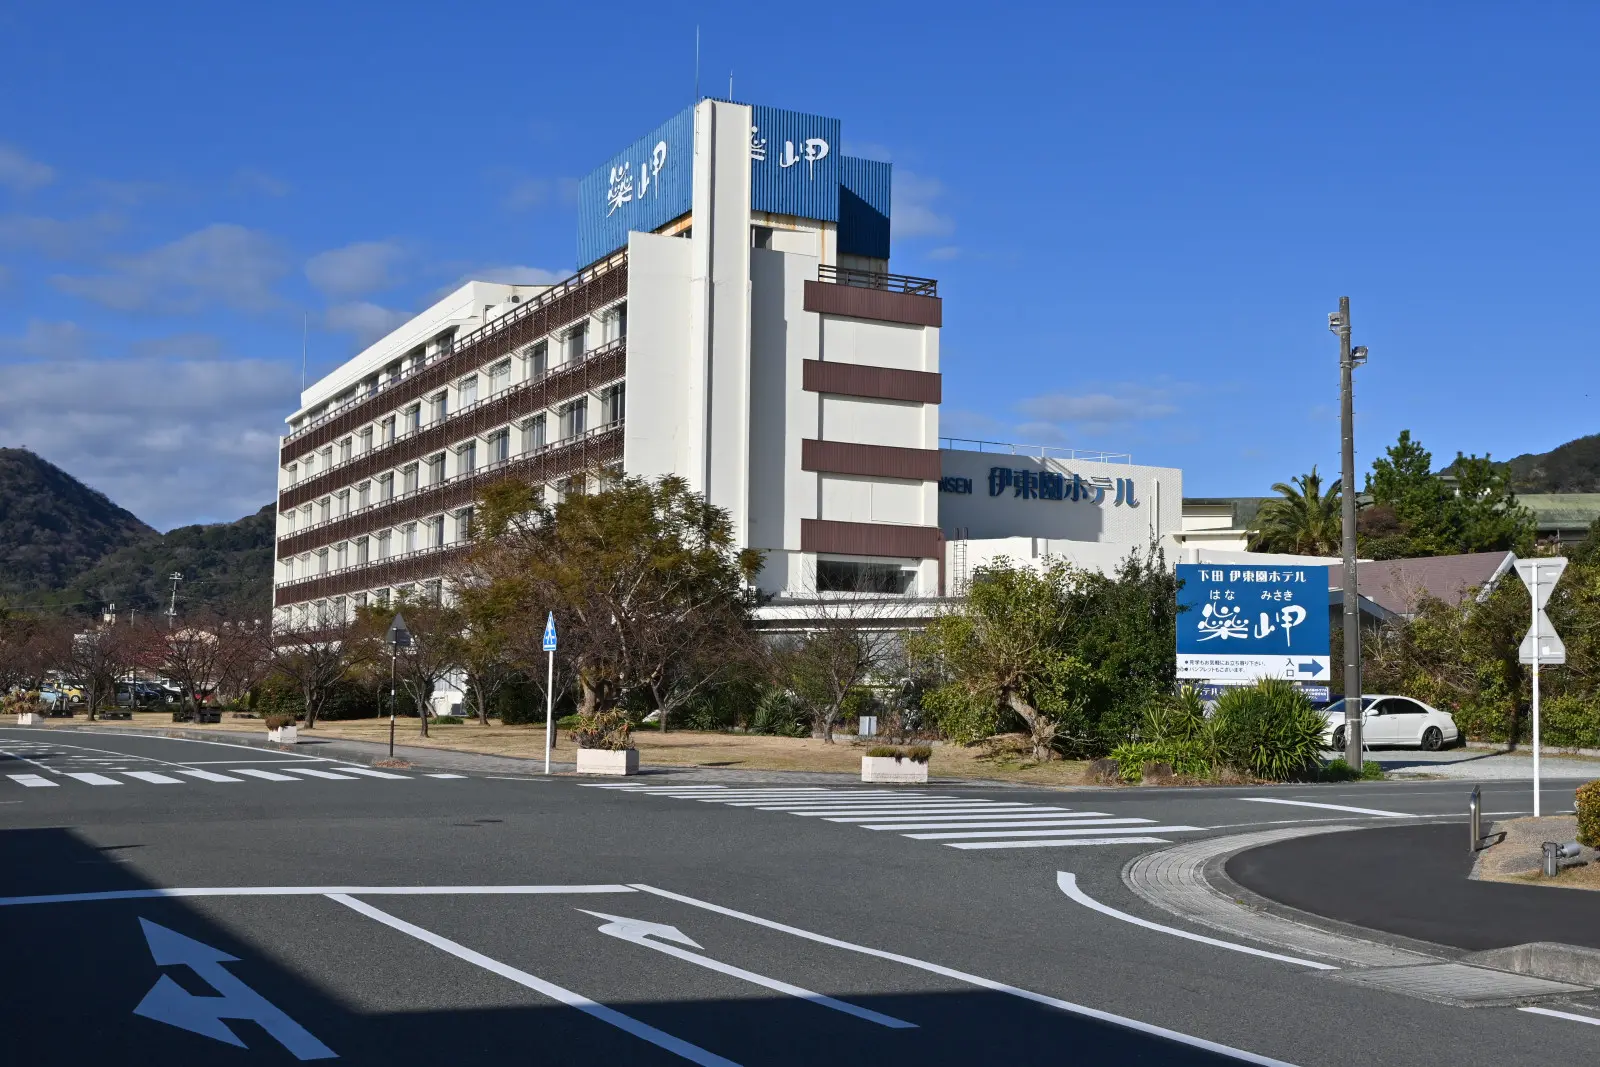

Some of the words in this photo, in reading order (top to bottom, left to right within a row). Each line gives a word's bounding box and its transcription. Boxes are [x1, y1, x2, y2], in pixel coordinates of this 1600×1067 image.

[988, 467, 1138, 507] 伊東園ホテル
[1198, 570, 1223, 582] 下田
[1230, 570, 1307, 583] 伊東園ホテル
[1210, 590, 1235, 600] はな
[1261, 590, 1294, 601] みさき
[1285, 658, 1295, 678] 入口
